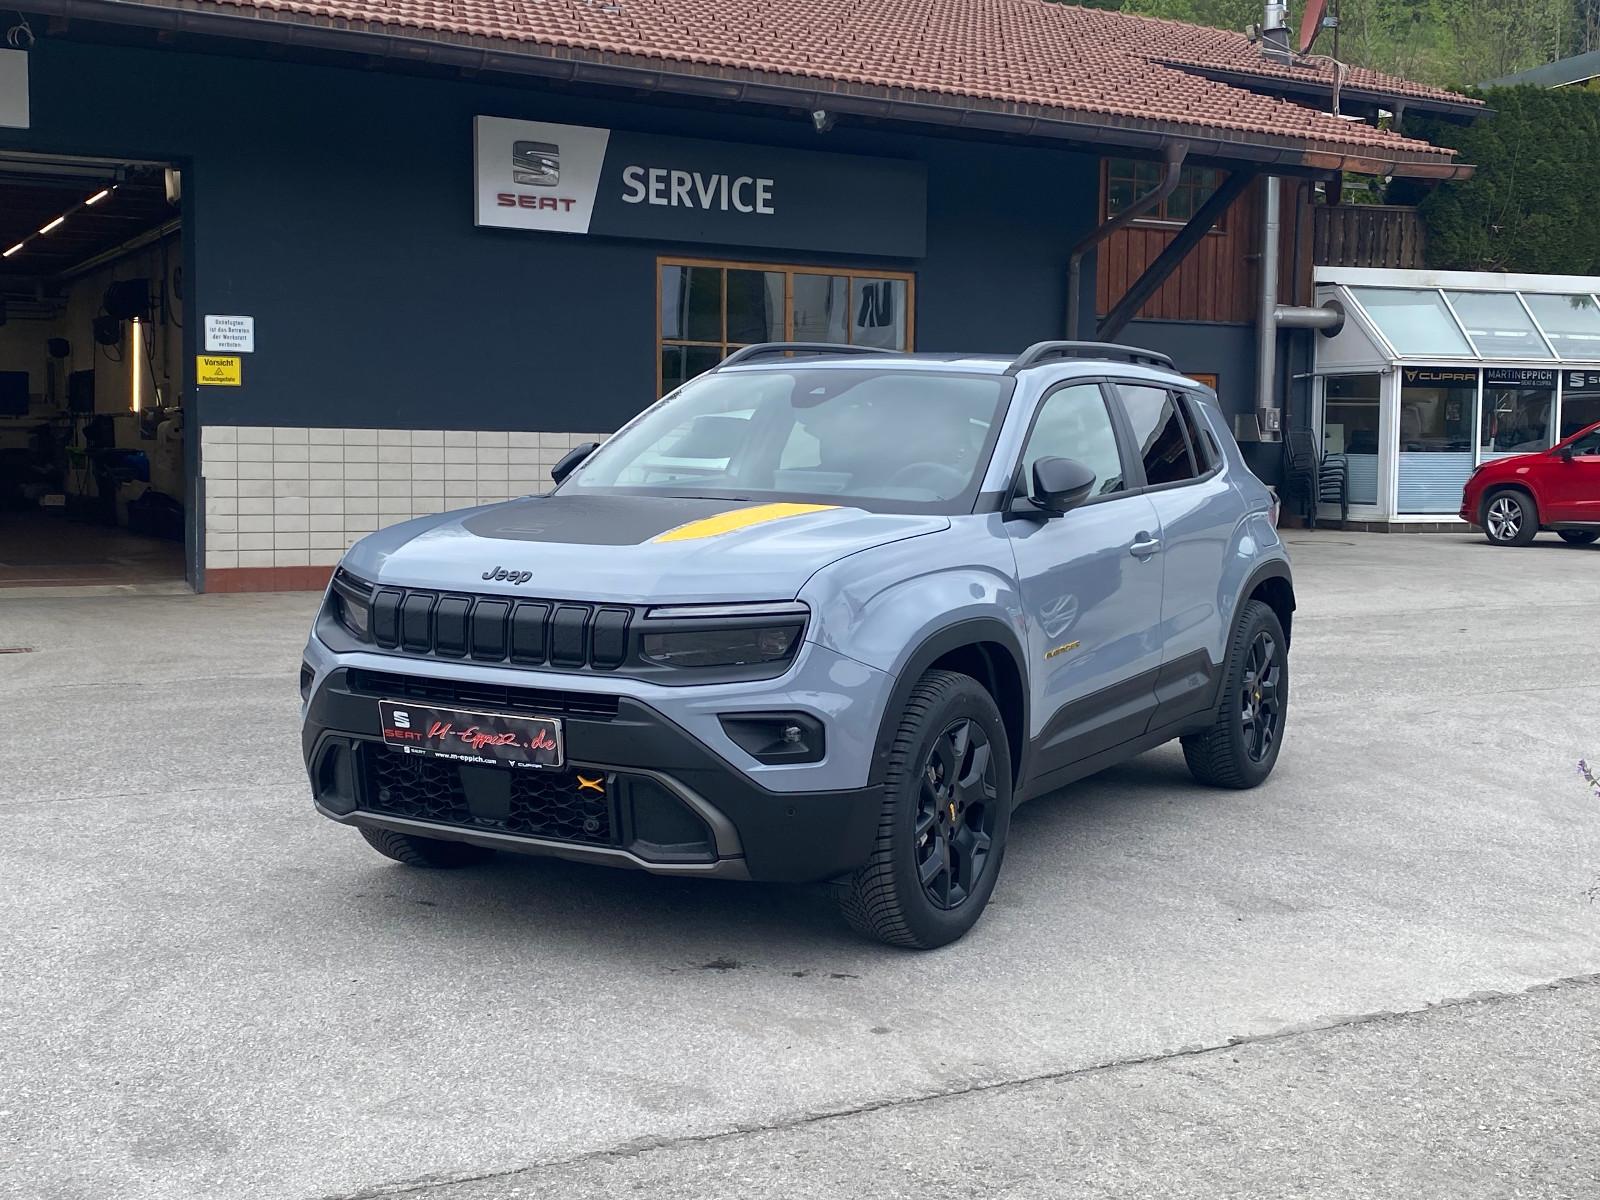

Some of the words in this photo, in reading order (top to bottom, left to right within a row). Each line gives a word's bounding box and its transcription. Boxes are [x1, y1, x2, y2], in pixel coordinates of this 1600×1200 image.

[622, 165, 775, 214] SERVICE
[497, 193, 577, 212] SEAT
[204, 358, 234, 367] Vorsicht
[1419, 372, 1475, 381] CUPRA
[1588, 376, 1600, 384] S
[481, 565, 533, 585] Jeep
[384, 728, 422, 740] SEAT
